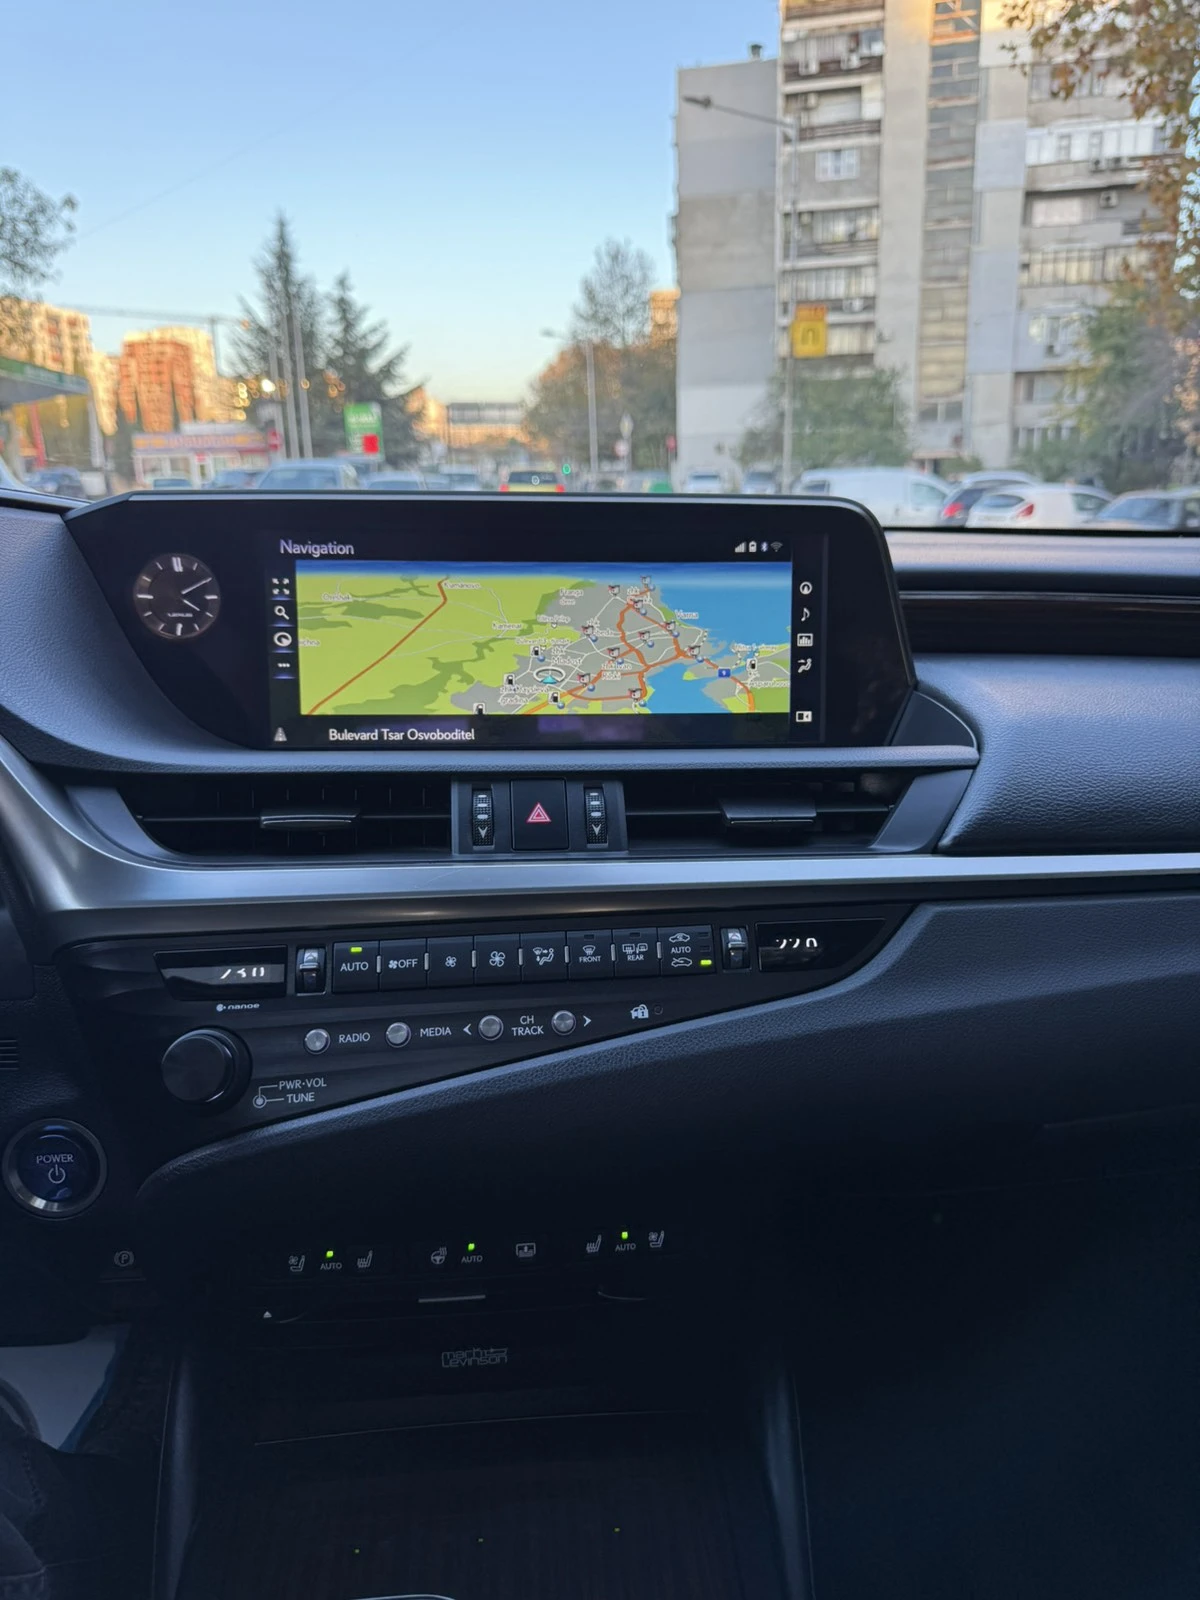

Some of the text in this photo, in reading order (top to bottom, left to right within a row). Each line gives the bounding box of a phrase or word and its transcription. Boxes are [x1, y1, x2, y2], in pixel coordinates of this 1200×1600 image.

[280, 540, 355, 557] Navigation
[328, 728, 475, 742] Bulevard Tsar Osvoboditel
[671, 946, 691, 954] AUTO
[579, 955, 601, 963] FRONT
[627, 953, 645, 961] REAR
[340, 961, 369, 972] AUTO
[398, 959, 418, 969] OFF
[520, 1015, 535, 1025] CH
[420, 1026, 452, 1038] MEDIA
[511, 1025, 544, 1037] TRACK
[338, 1032, 371, 1044] RADIO
[286, 1092, 315, 1104] TUNE
[36, 1153, 74, 1164] POWER
[614, 1242, 636, 1252] AUTO
[461, 1254, 483, 1264] AUTO
[320, 1261, 342, 1271] AUTO
